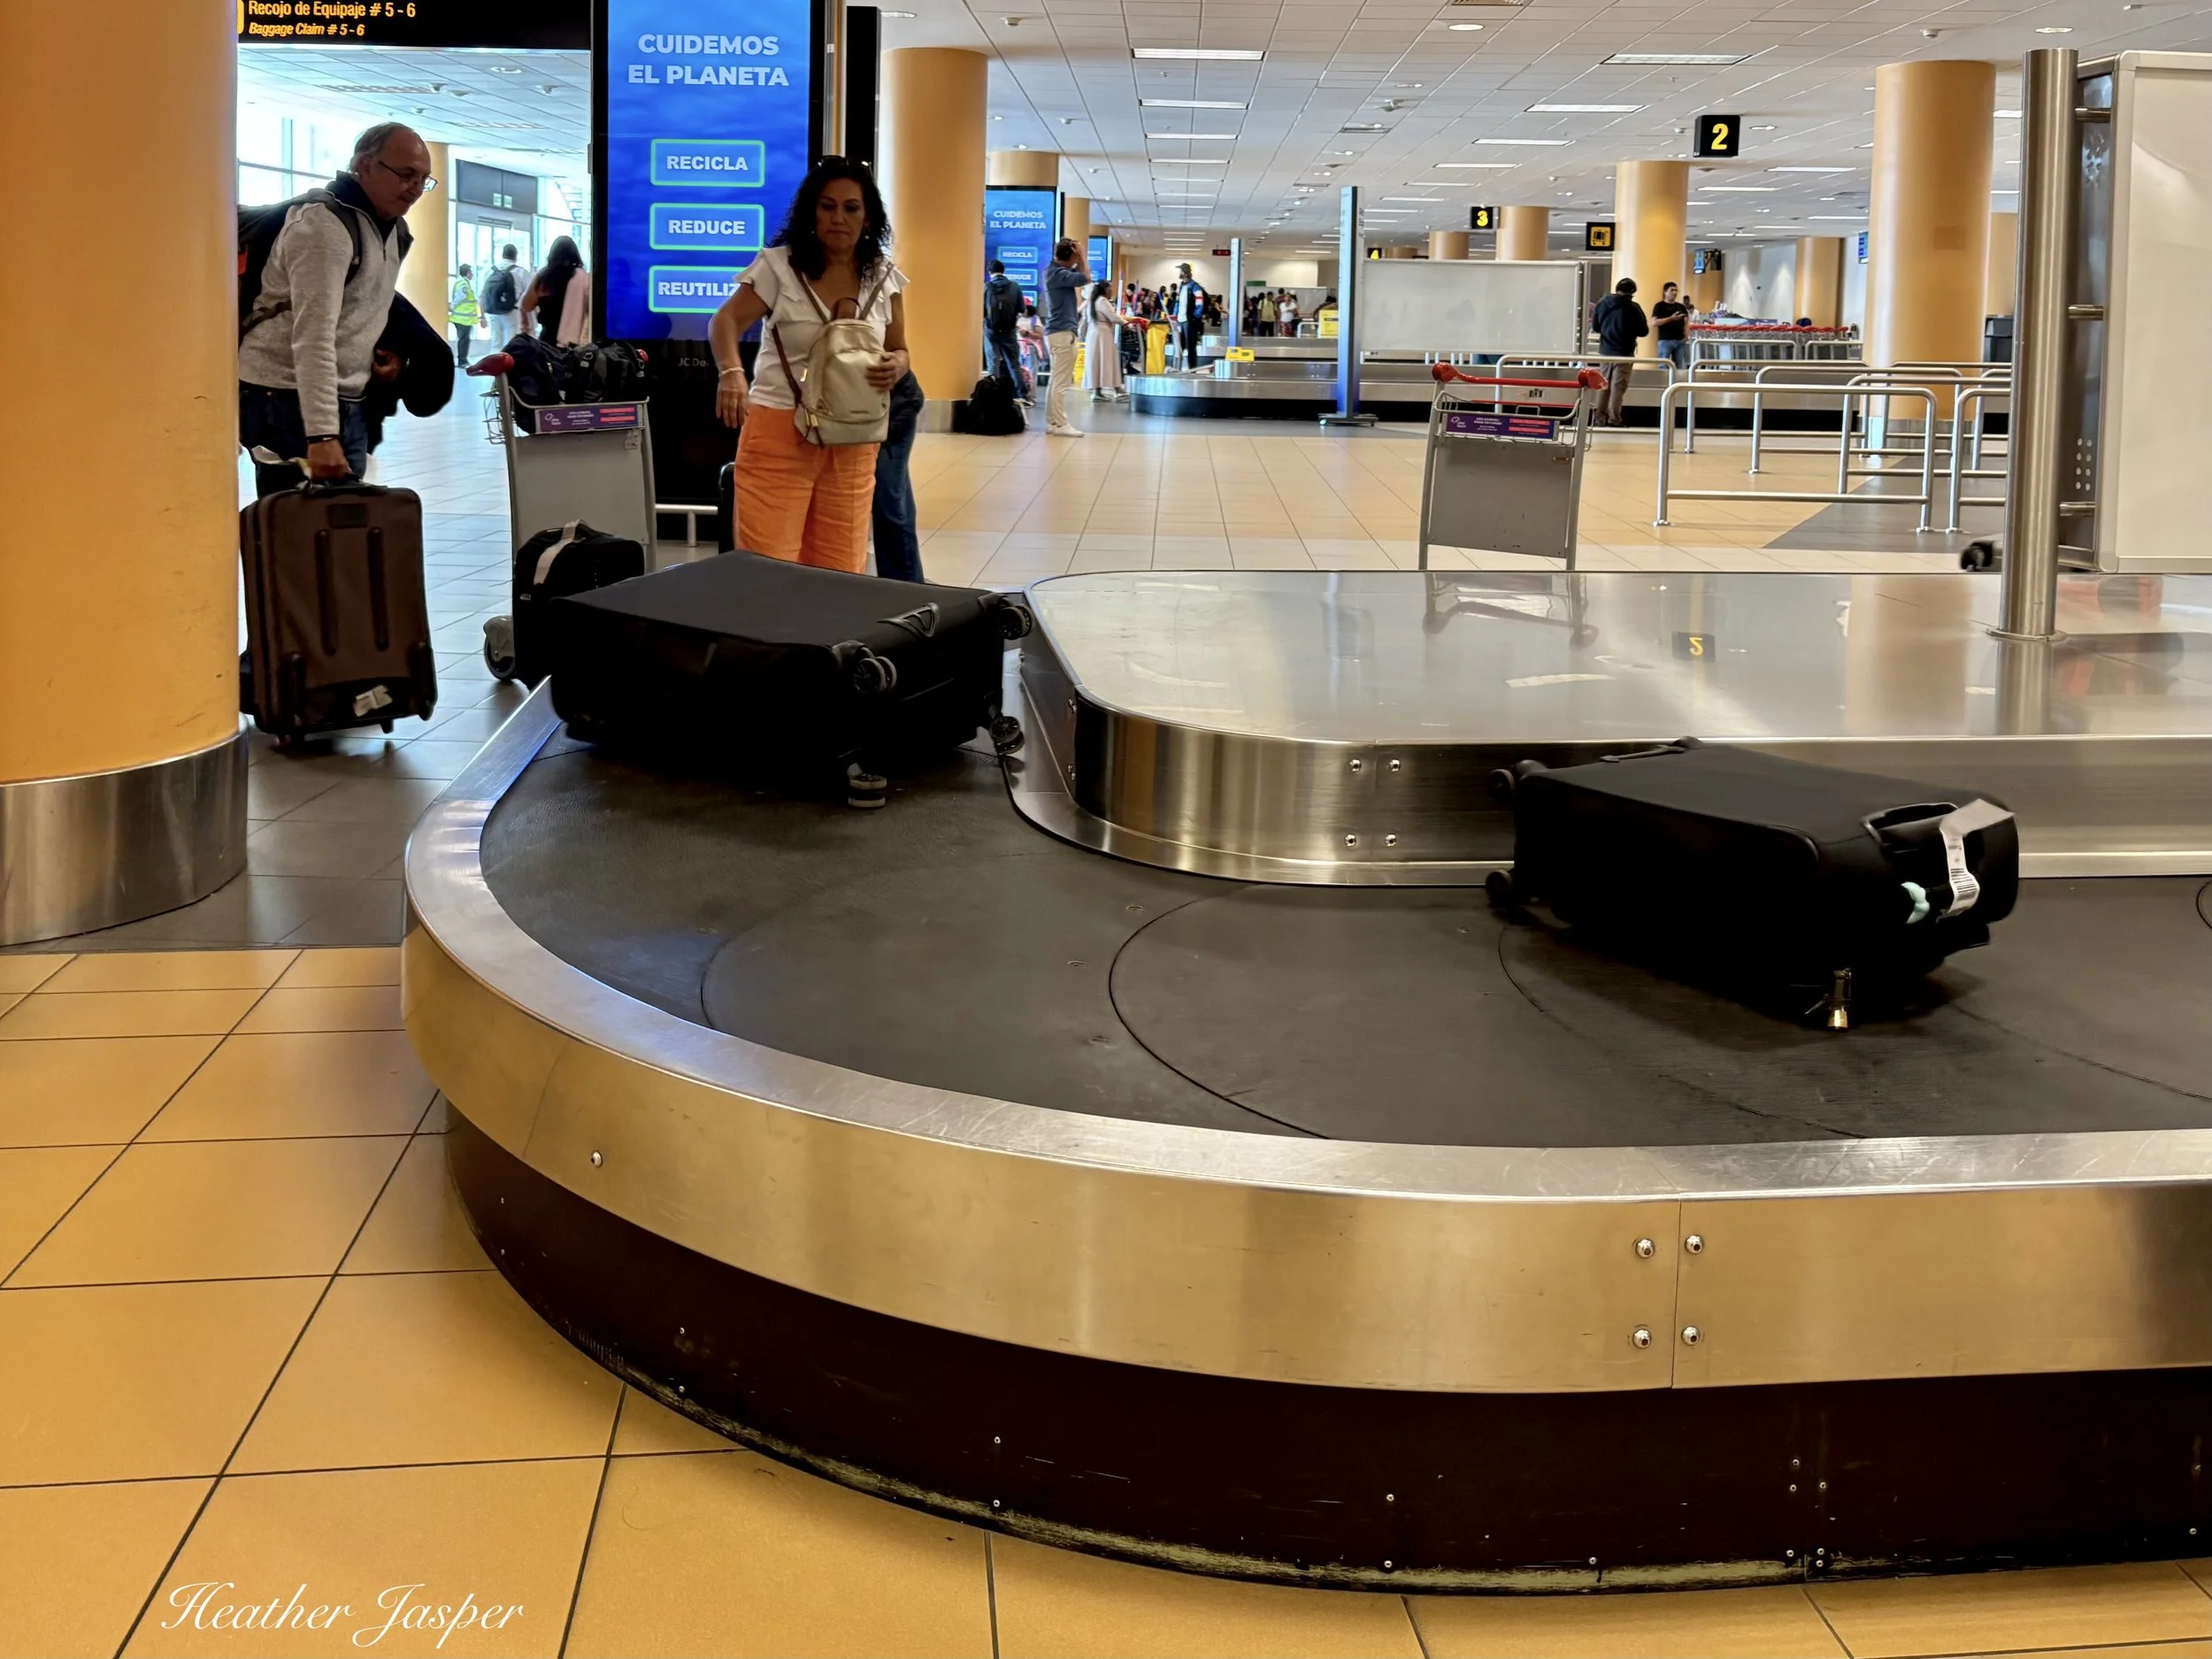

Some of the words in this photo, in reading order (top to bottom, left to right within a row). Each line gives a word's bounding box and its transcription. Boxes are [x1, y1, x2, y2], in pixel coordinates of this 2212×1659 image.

[249, 0, 292, 18] Recojo
[295, 1, 311, 16] de
[313, 1, 366, 19] Equipaje
[369, 3, 382, 17] #
[385, 2, 395, 18] 5
[407, 3, 416, 18] 6
[249, 22, 294, 36] Baggage
[296, 22, 325, 35] Claim
[327, 24, 338, 35] #
[340, 24, 349, 35] 5
[357, 24, 365, 36] 6
[638, 34, 780, 55] CUIDEMOS
[628, 65, 660, 84] EL
[666, 65, 789, 87] PLANETA
[1711, 123, 1728, 150] 2
[666, 156, 748, 171] RECICLA
[668, 220, 745, 234] REDUCE
[1477, 211, 1488, 227] 3
